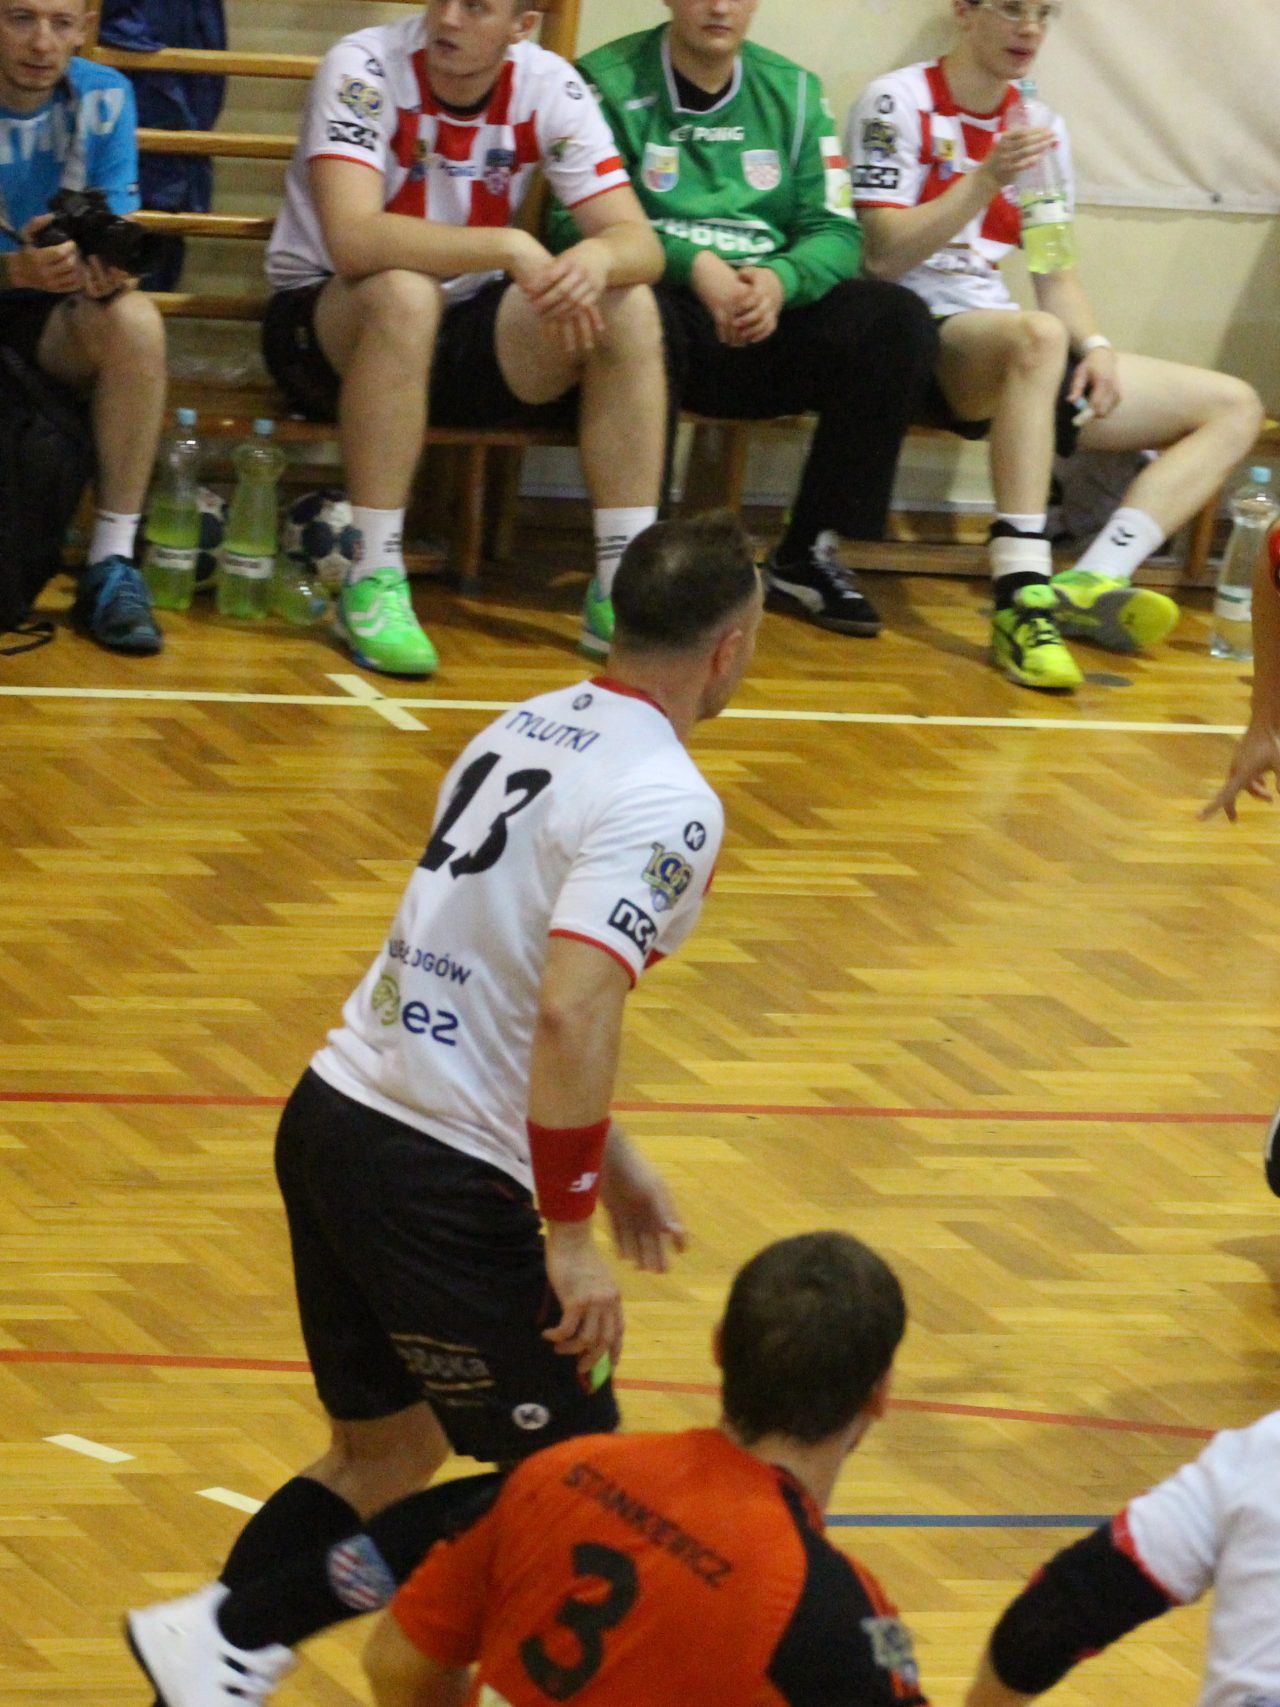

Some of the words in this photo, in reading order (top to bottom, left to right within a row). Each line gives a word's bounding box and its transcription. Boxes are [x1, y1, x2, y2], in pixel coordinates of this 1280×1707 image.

[505, 711, 601, 753] TYLUTKI
[417, 751, 553, 880] 13
[519, 1542, 640, 1702] 3
